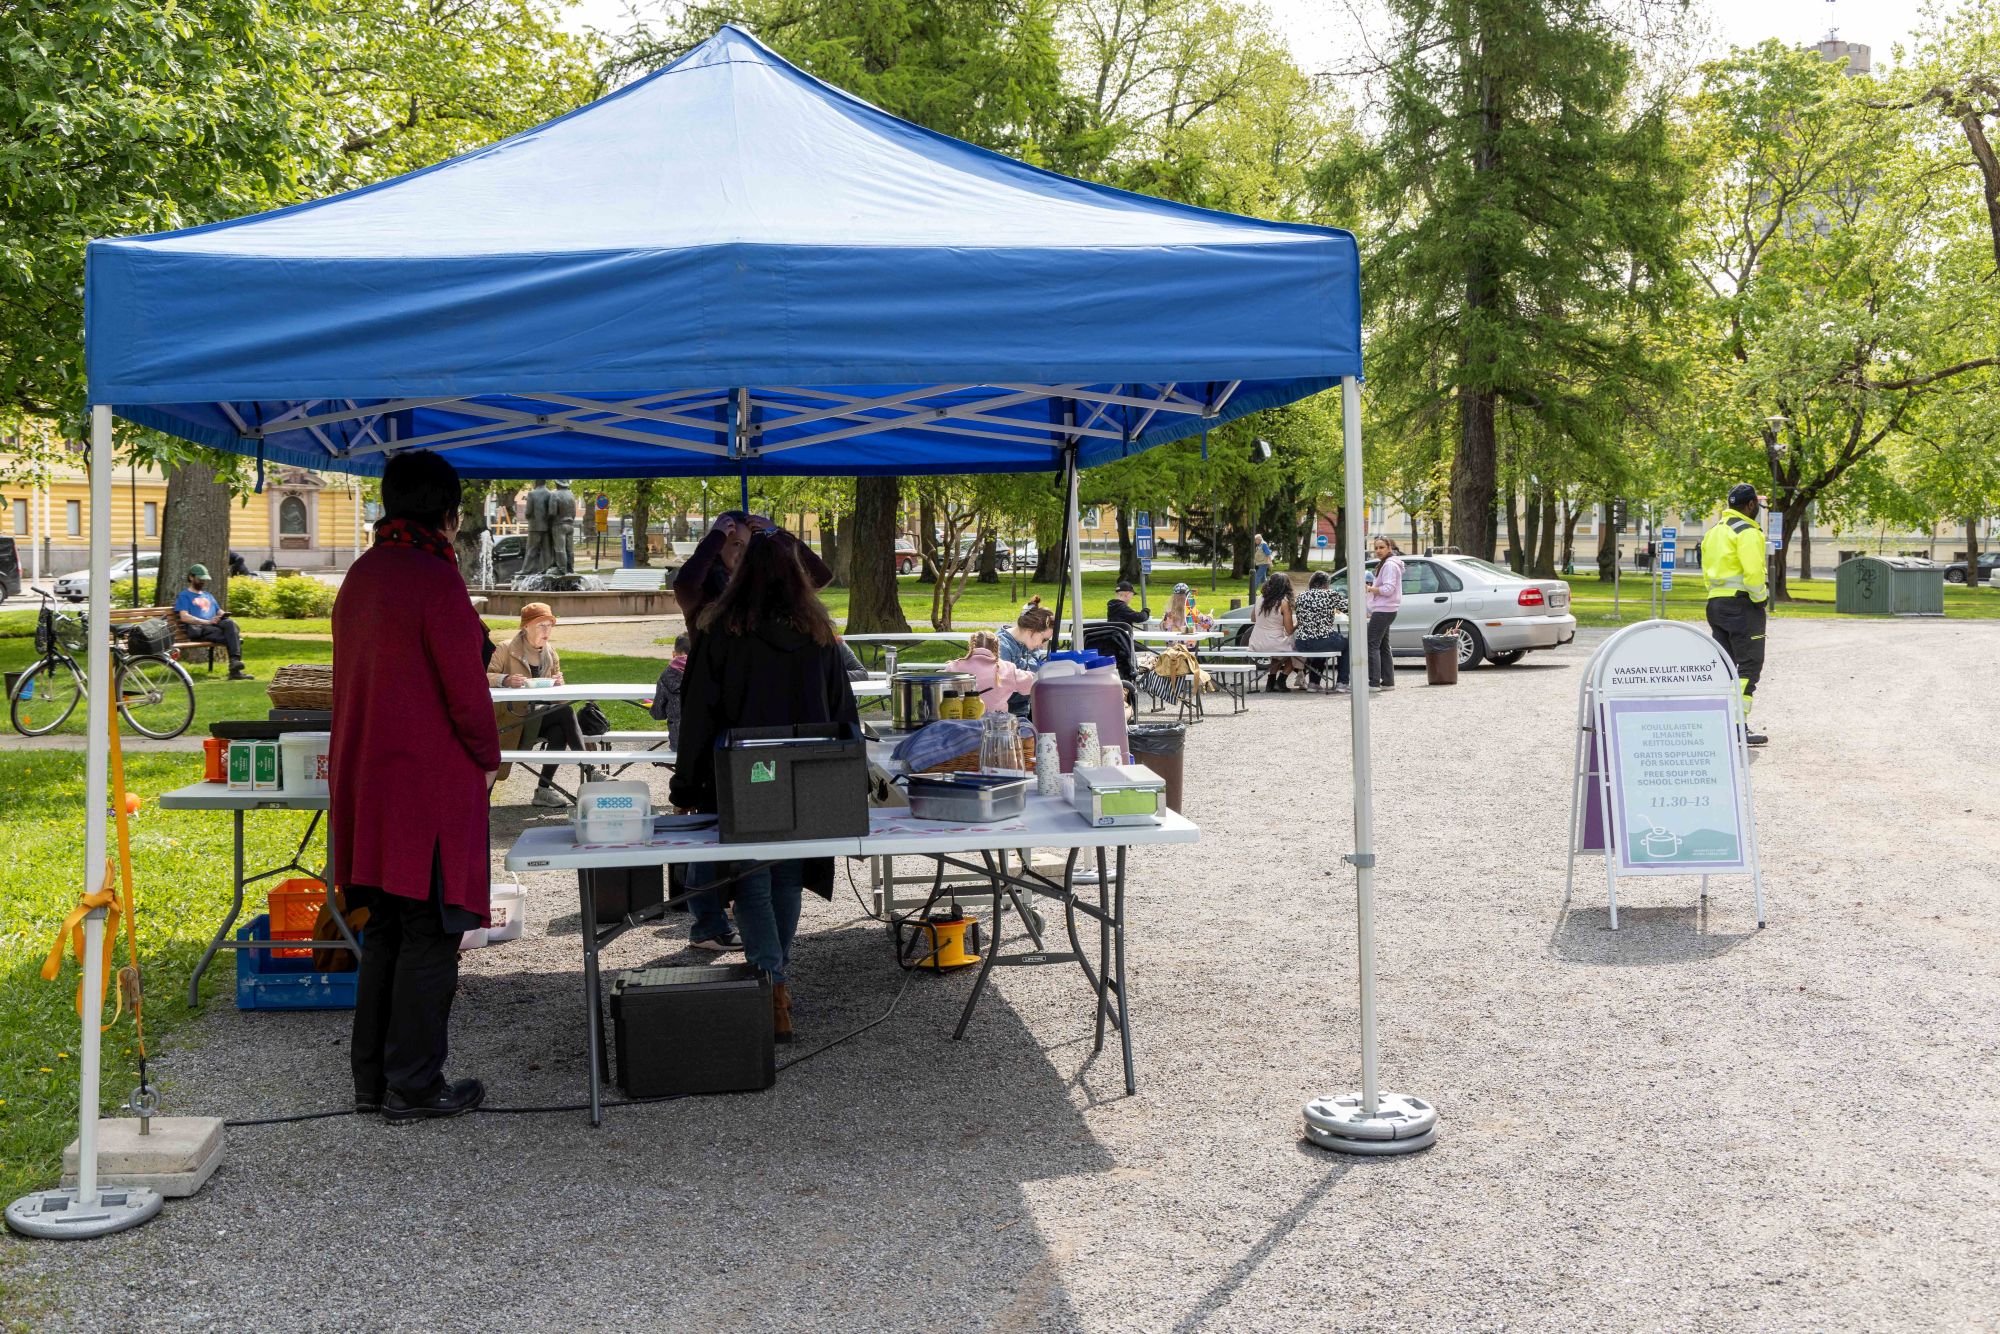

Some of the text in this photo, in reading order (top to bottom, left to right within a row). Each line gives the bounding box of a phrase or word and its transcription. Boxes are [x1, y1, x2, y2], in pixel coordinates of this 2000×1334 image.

[1614, 664, 1712, 675] VAASAN EV.LUT. KIRKKO
[1612, 676, 1649, 685] EV.LUTH.
[1650, 675, 1684, 684] KYRKAN
[1691, 674, 1713, 682] VASA
[1641, 723, 1703, 731] KOULULAISTEN
[1652, 731, 1693, 739] ILMAINEN
[1642, 738, 1705, 747] KEITTOLOUNAS
[1633, 750, 1716, 759] GRATIS SOPPLUNCH
[1640, 758, 1711, 767] FÖR SKOLELEVER
[1644, 770, 1665, 778] FREE
[1691, 769, 1708, 777] FOR
[1674, 777, 1717, 785] CHILDREN
